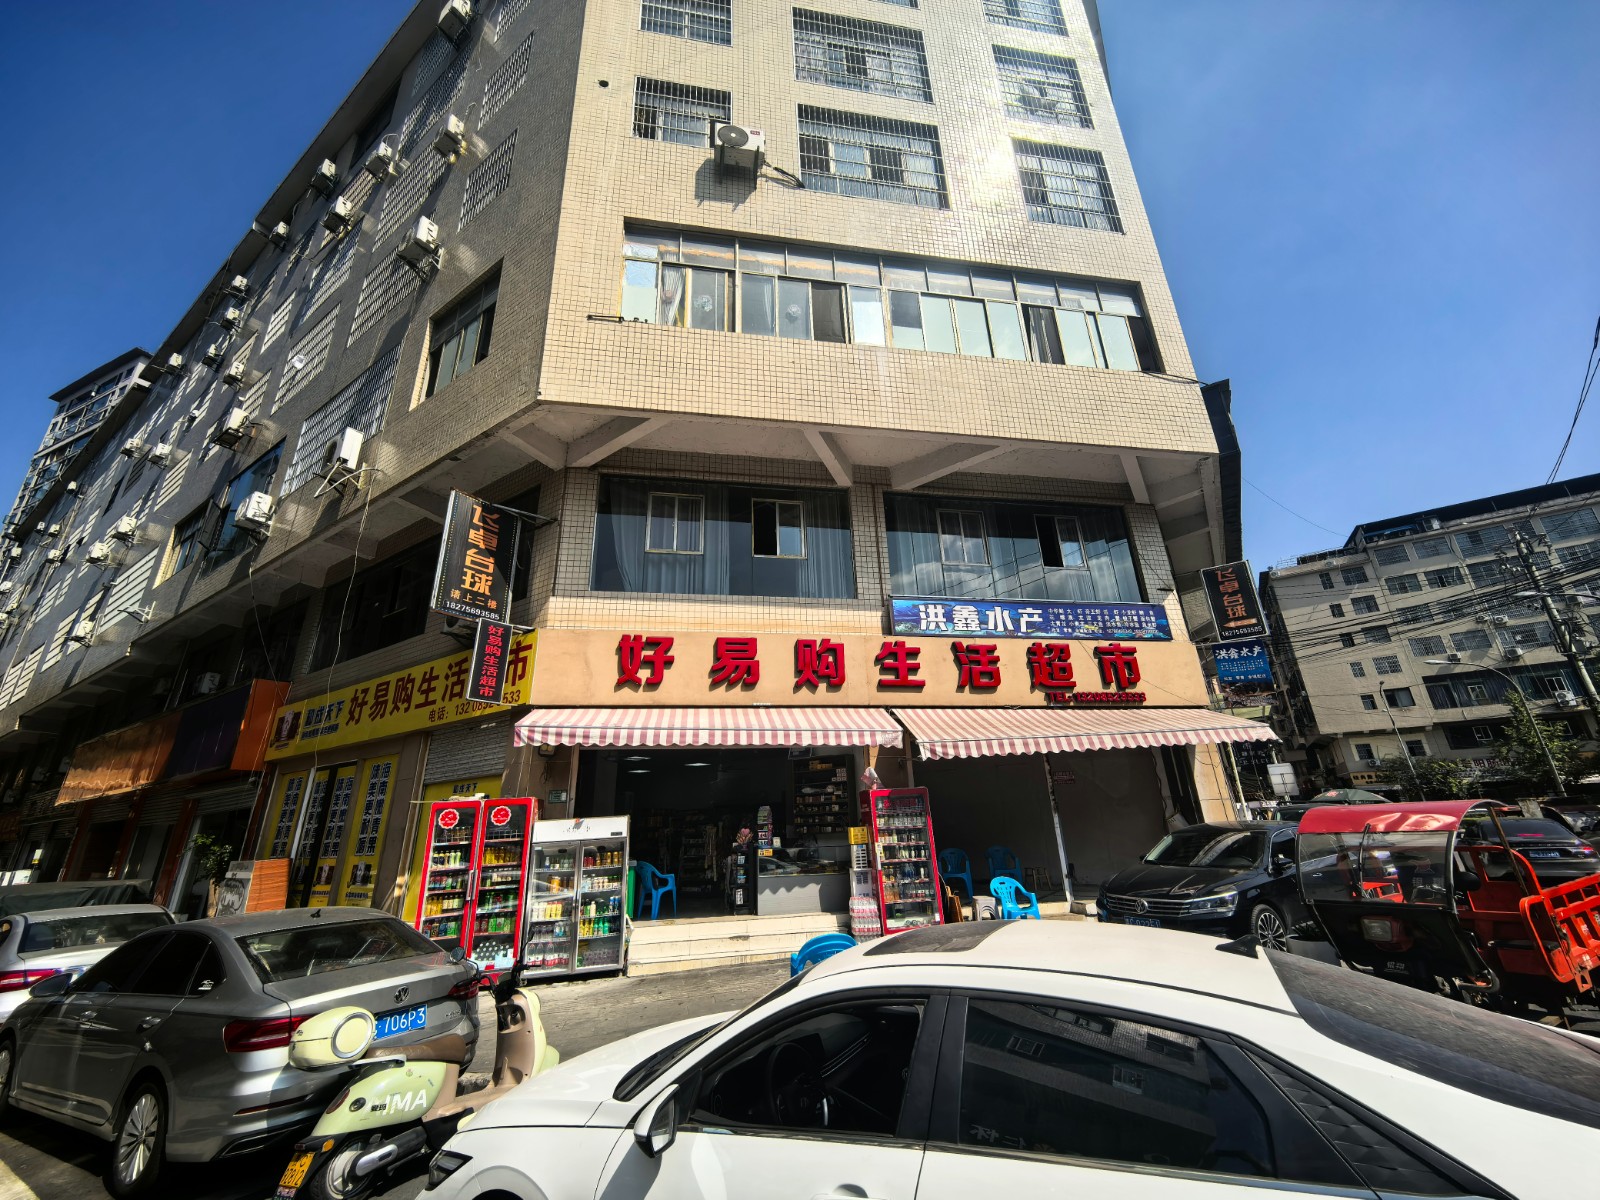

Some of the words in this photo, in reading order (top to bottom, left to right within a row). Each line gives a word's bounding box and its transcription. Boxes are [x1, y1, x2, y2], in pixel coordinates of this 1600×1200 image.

[445, 600, 500, 620] 18275693585
[450, 588, 498, 609] 请上二楼
[918, 604, 1043, 633] 洪鑫水产
[479, 624, 505, 697] 好易购生活超市
[617, 634, 1142, 690] 好易购生活超市
[346, 639, 533, 726] 好易购生活市
